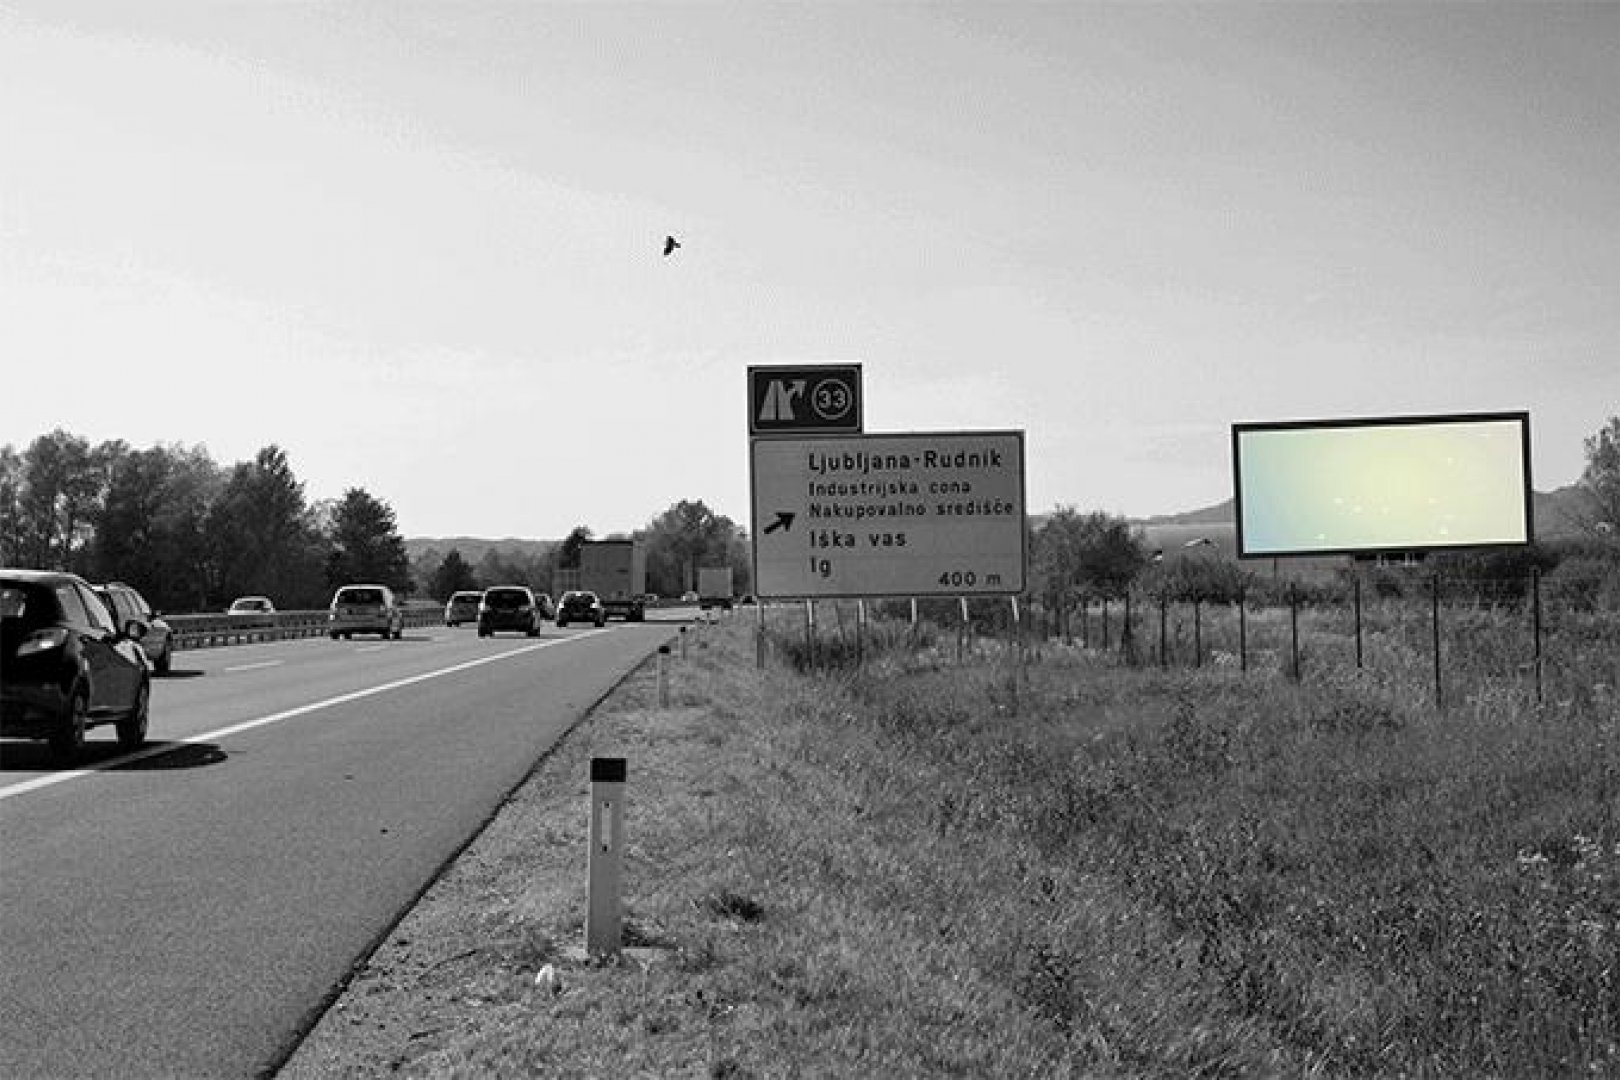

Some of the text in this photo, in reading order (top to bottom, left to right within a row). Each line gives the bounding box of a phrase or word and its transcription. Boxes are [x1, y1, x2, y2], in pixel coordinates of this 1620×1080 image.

[817, 389, 846, 408] 33
[809, 450, 1002, 474] Ljubljana-Rudnik
[809, 481, 971, 498] Industrijska cona
[809, 502, 927, 520] Nakupovalno
[869, 532, 907, 547] vas
[811, 557, 832, 577] Ig
[939, 571, 1001, 587] 400 m
